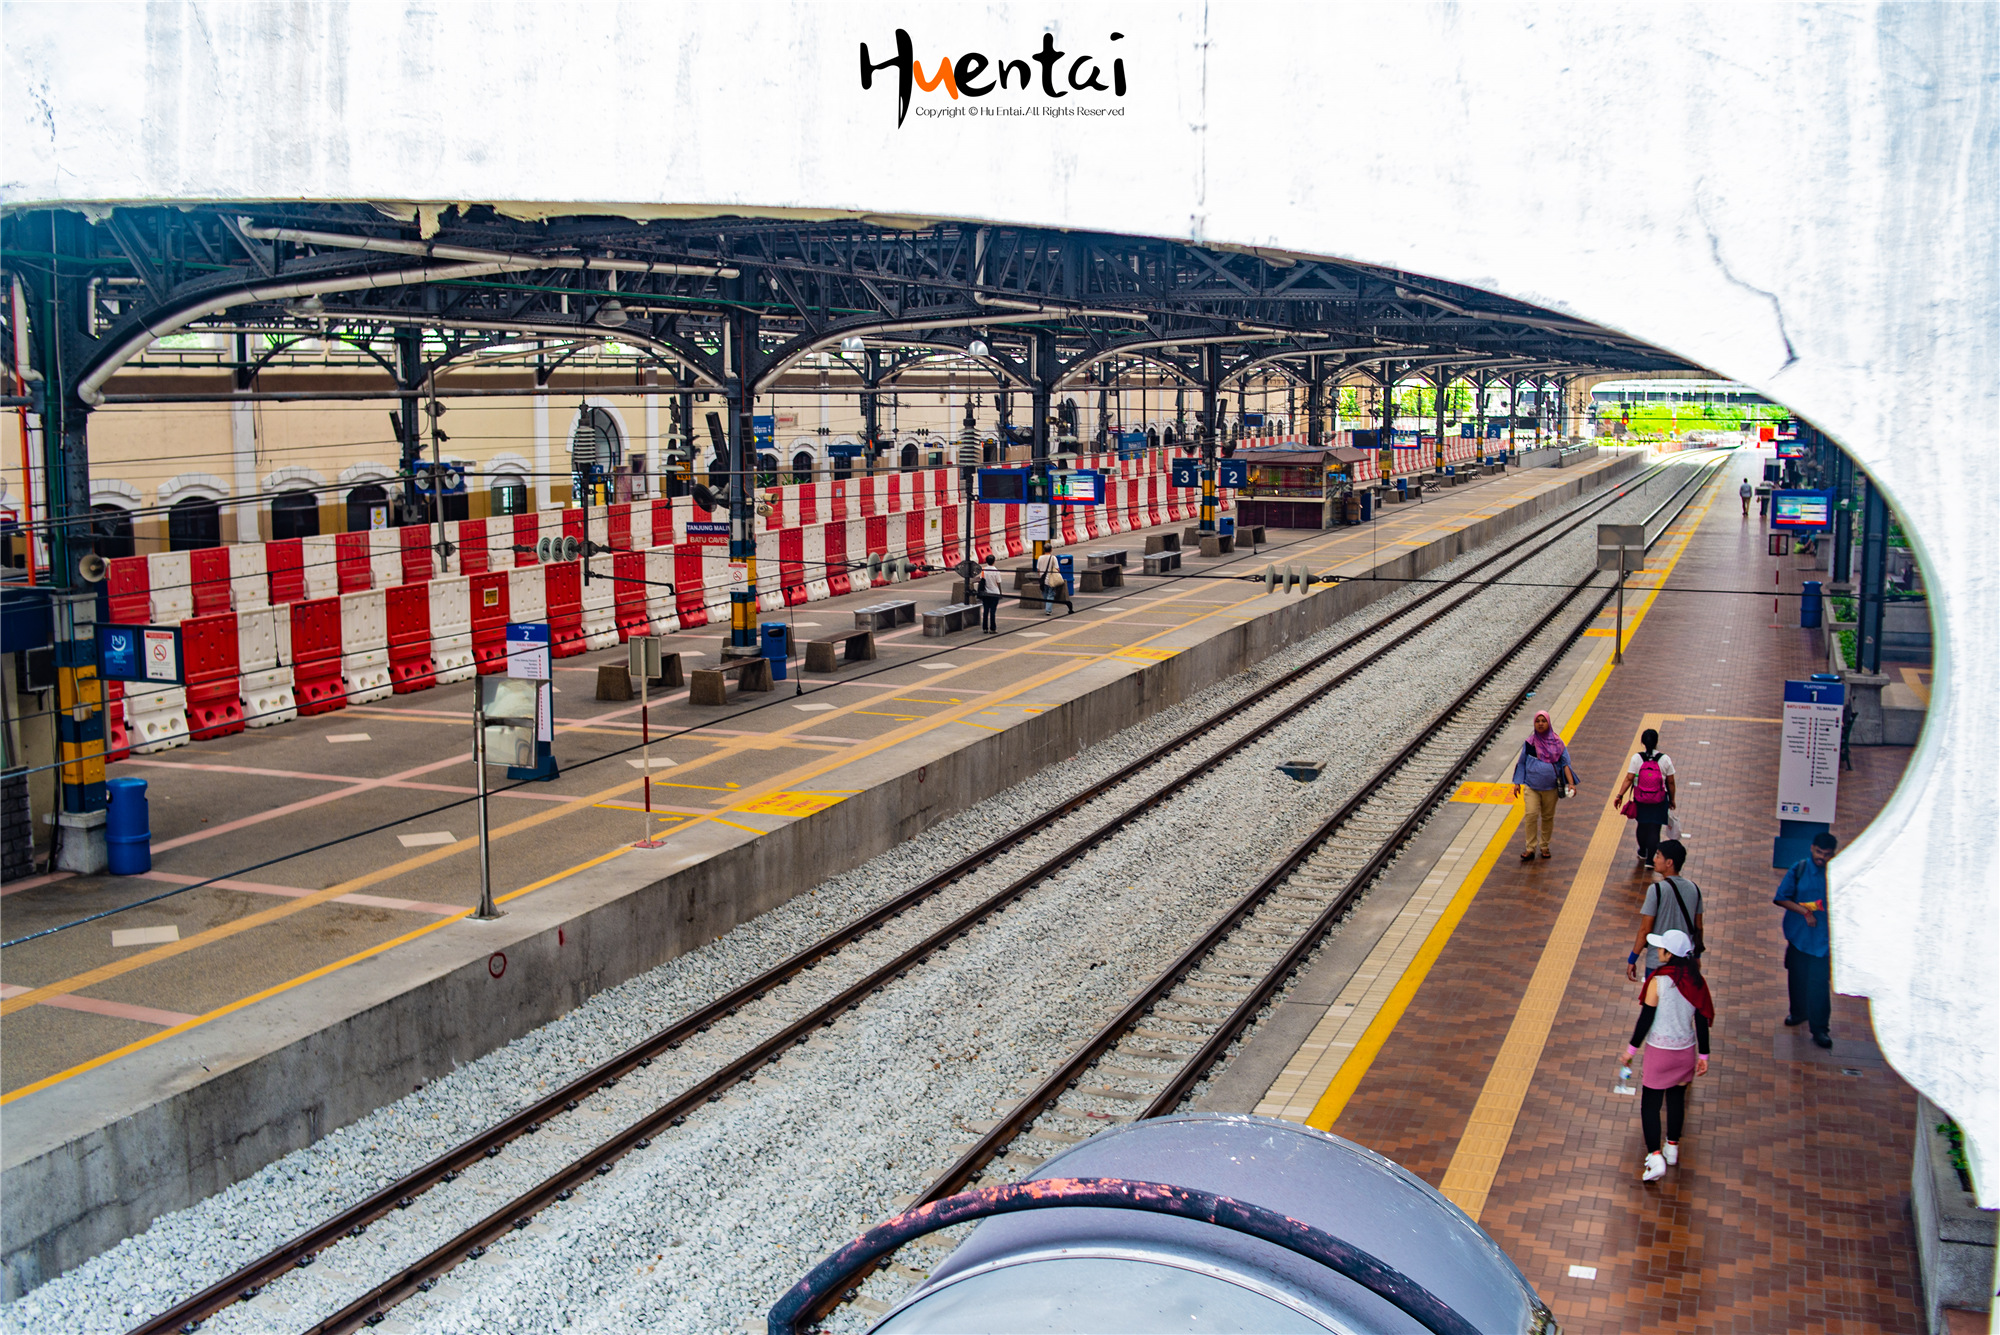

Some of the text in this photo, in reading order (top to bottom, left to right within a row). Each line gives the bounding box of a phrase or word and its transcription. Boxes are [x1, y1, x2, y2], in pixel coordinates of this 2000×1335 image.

[1181, 470, 1189, 483] 3
[1229, 471, 1238, 484] 2
[524, 631, 530, 640] 2
[1812, 690, 1818, 702] 1
